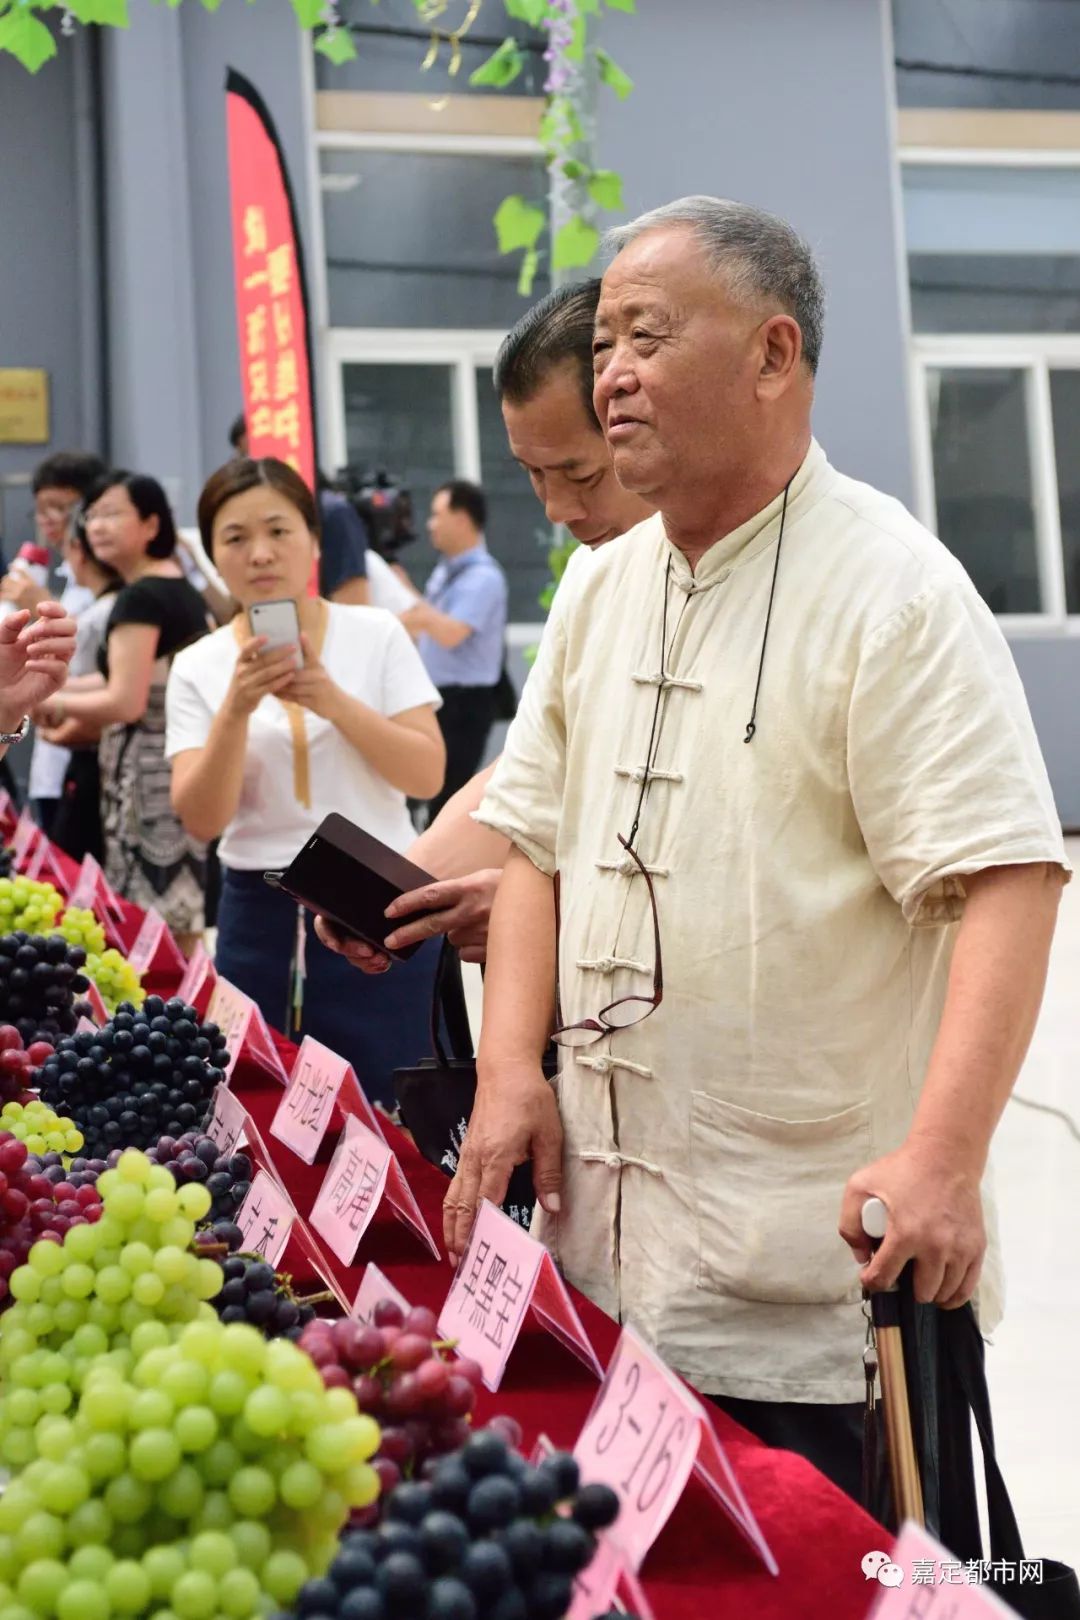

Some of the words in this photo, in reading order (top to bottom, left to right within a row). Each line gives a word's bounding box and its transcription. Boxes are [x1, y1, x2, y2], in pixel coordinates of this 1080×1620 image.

[331, 1146, 380, 1231] 高尾
[459, 1240, 524, 1349] 早黑宝
[595, 1362, 686, 1513] 3-16
